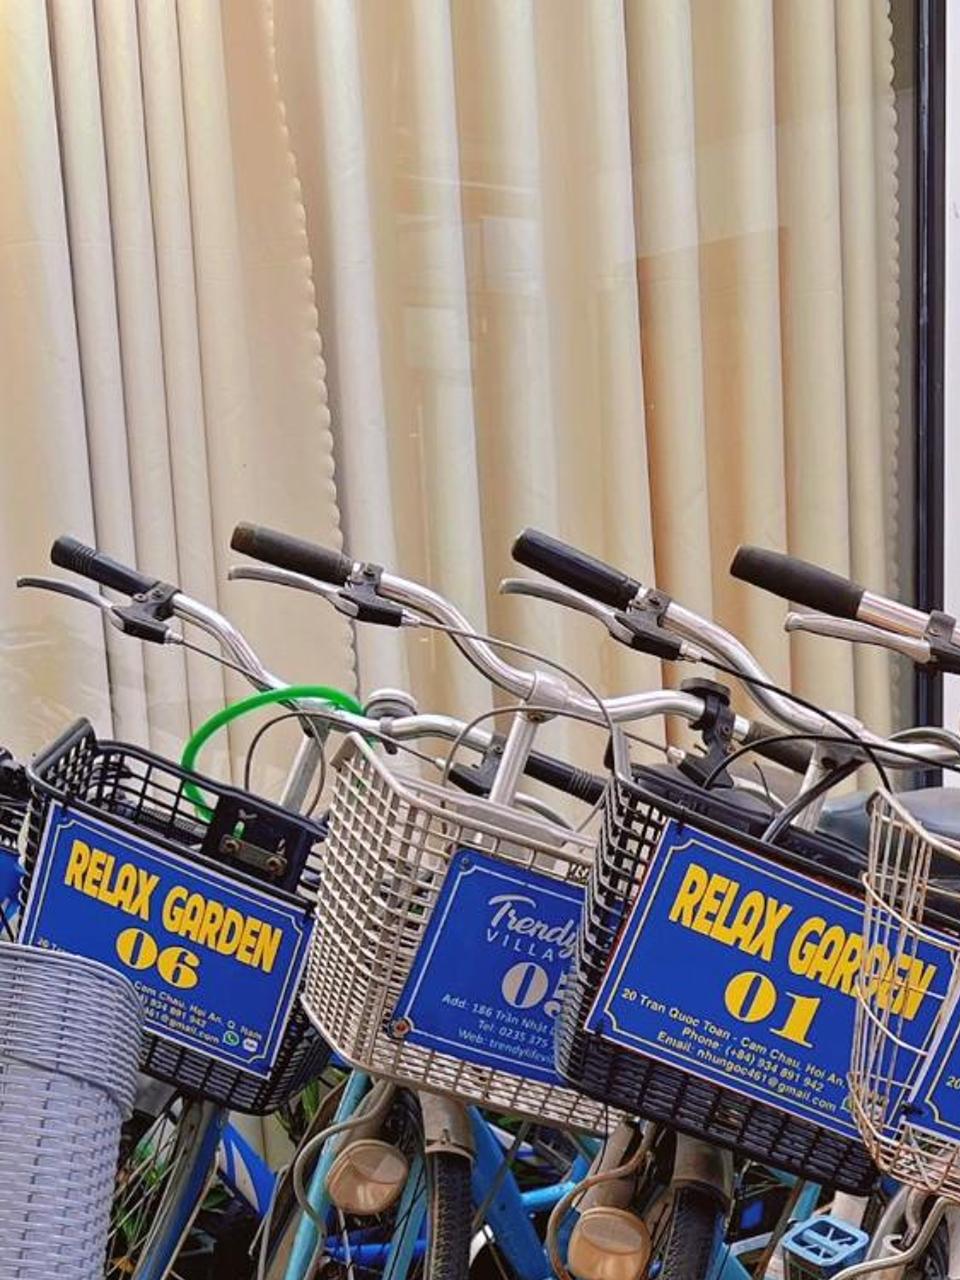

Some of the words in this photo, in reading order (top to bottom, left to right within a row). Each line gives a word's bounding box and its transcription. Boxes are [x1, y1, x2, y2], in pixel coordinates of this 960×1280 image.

[64, 838, 160, 922] RELAX
[162, 886, 283, 974] GARDEN
[488, 894, 577, 959] Trendy
[668, 862, 793, 963] RELAX
[788, 916, 938, 1021] GARDEN
[115, 927, 201, 990] 06
[486, 927, 554, 962] VILLA
[621, 987, 638, 1001] 20
[639, 994, 667, 1014] Tran
[668, 1007, 701, 1027] Quoc
[703, 1020, 731, 1040] Toan
[740, 1036, 767, 1055] Cam
[805, 1063, 825, 1080] Hoi
[724, 971, 821, 1049] 01
[725, 1044, 756, 1066] (+84)
[757, 1057, 779, 1073] 934
[803, 1076, 825, 1093] 942
